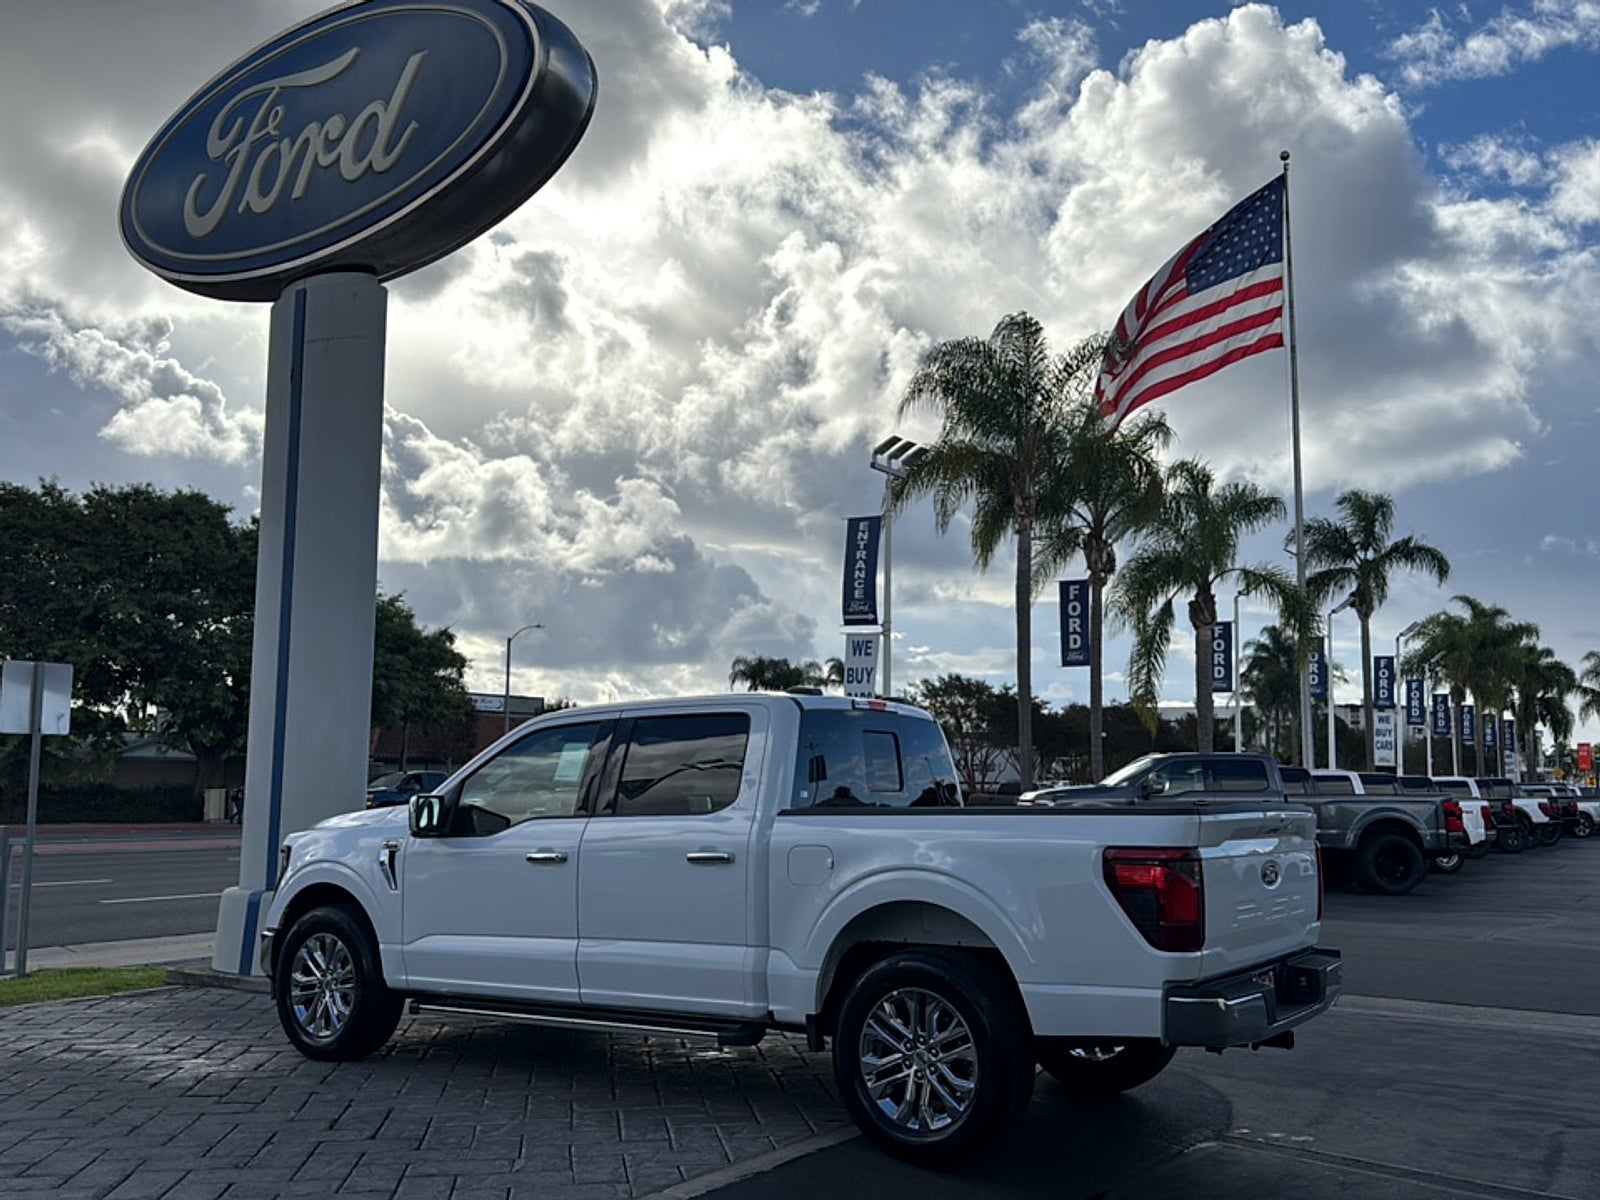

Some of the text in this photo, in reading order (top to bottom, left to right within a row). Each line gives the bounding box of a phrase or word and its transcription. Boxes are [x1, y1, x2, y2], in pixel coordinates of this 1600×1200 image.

[183, 46, 428, 238] Ford
[853, 521, 869, 599] ENTRANCE
[1068, 584, 1082, 650] FORD
[852, 640, 873, 657] WE
[1213, 625, 1225, 679] FORD
[1308, 648, 1320, 685] ORD
[846, 667, 874, 684] BUY
[1379, 659, 1389, 698] FORD
[1411, 682, 1420, 716] FORD
[1377, 715, 1391, 724] WE
